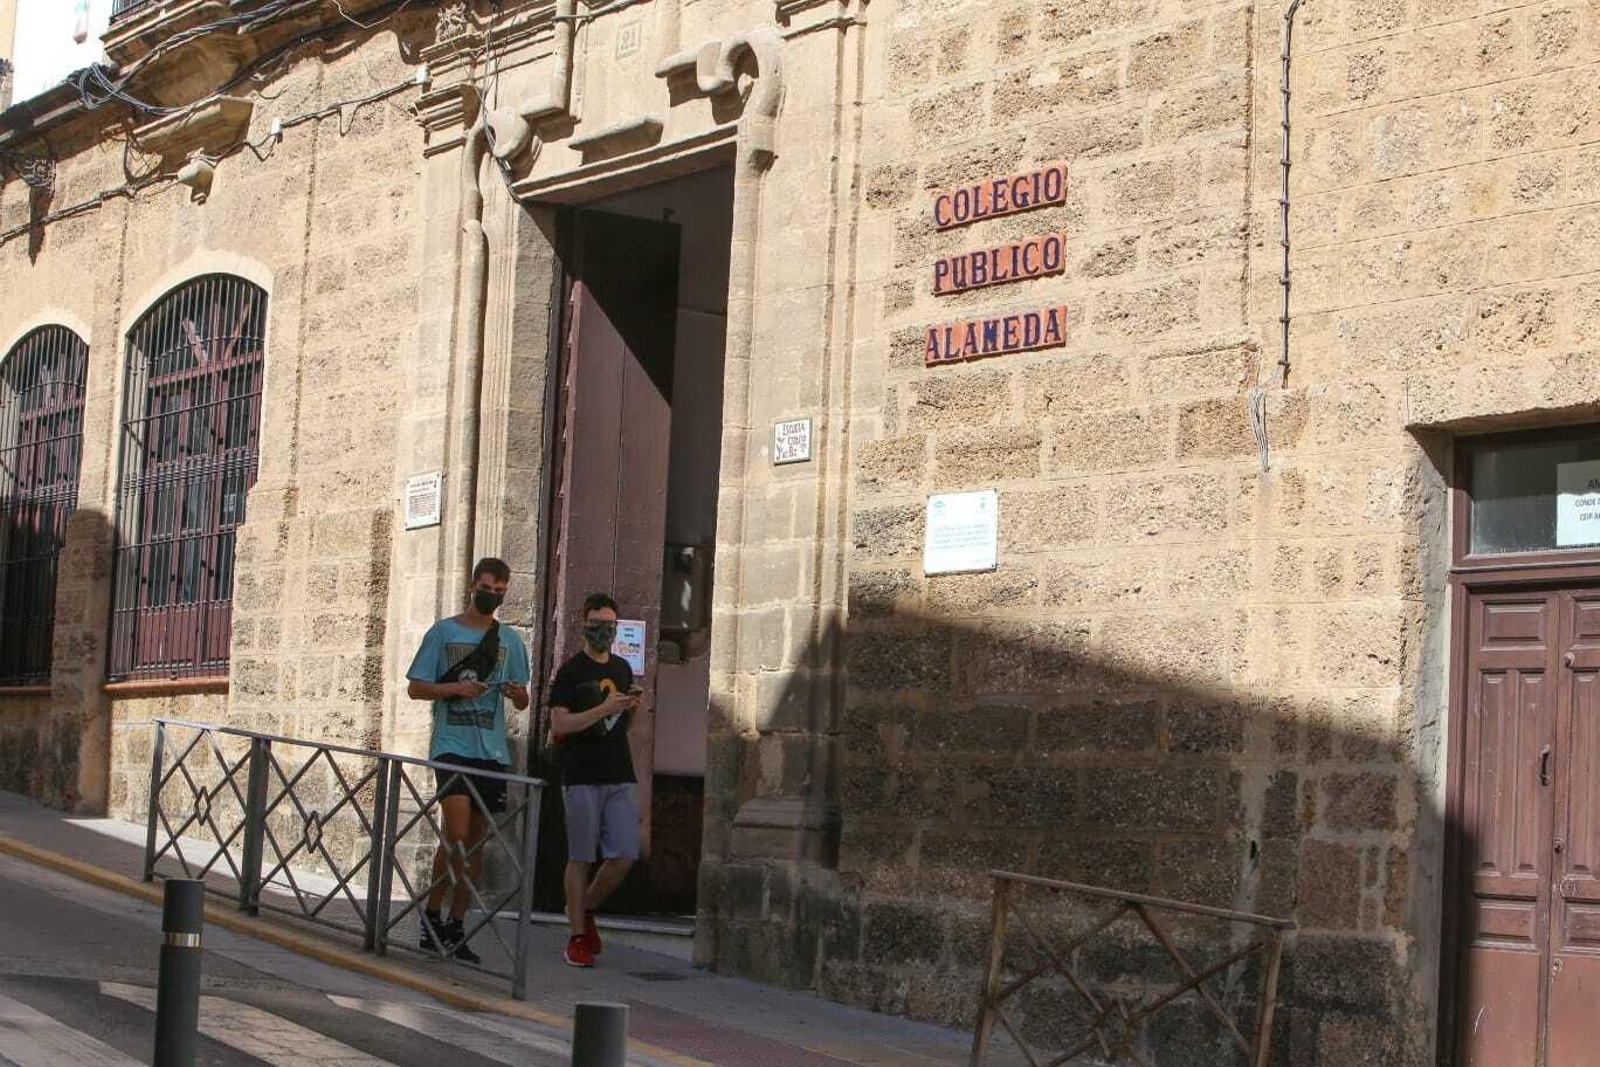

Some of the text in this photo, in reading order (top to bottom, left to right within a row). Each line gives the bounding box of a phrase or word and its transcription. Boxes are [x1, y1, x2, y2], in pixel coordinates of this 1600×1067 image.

[935, 168, 1062, 226] COLEGIO
[934, 237, 1060, 292] PUBLICO
[925, 308, 1062, 361] ALAMEDA
